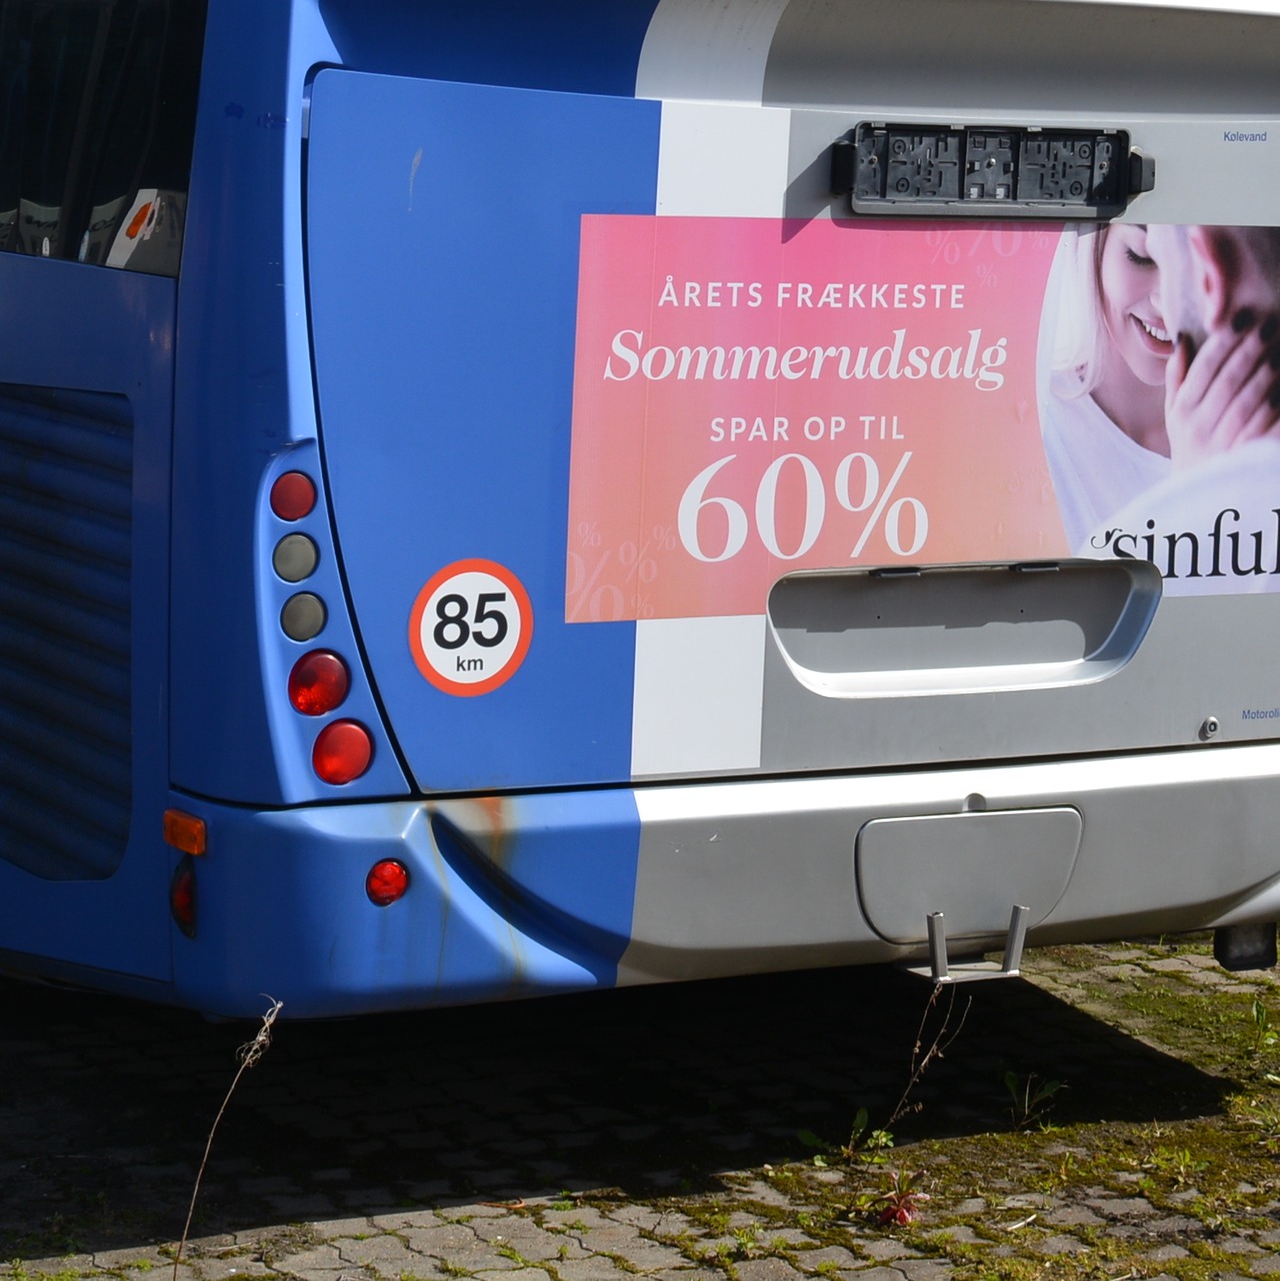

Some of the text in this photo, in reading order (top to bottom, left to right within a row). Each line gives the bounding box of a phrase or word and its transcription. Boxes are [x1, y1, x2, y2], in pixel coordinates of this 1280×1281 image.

[1223, 130, 1268, 143] Kølevand
[658, 275, 965, 309] ÅRETS FRÆKKESTE
[603, 328, 1008, 392] Sommerudsalg
[709, 416, 905, 443] SPAR OP TIL
[677, 451, 930, 563] 60%
[433, 592, 509, 650] 85
[456, 655, 484, 672] km
